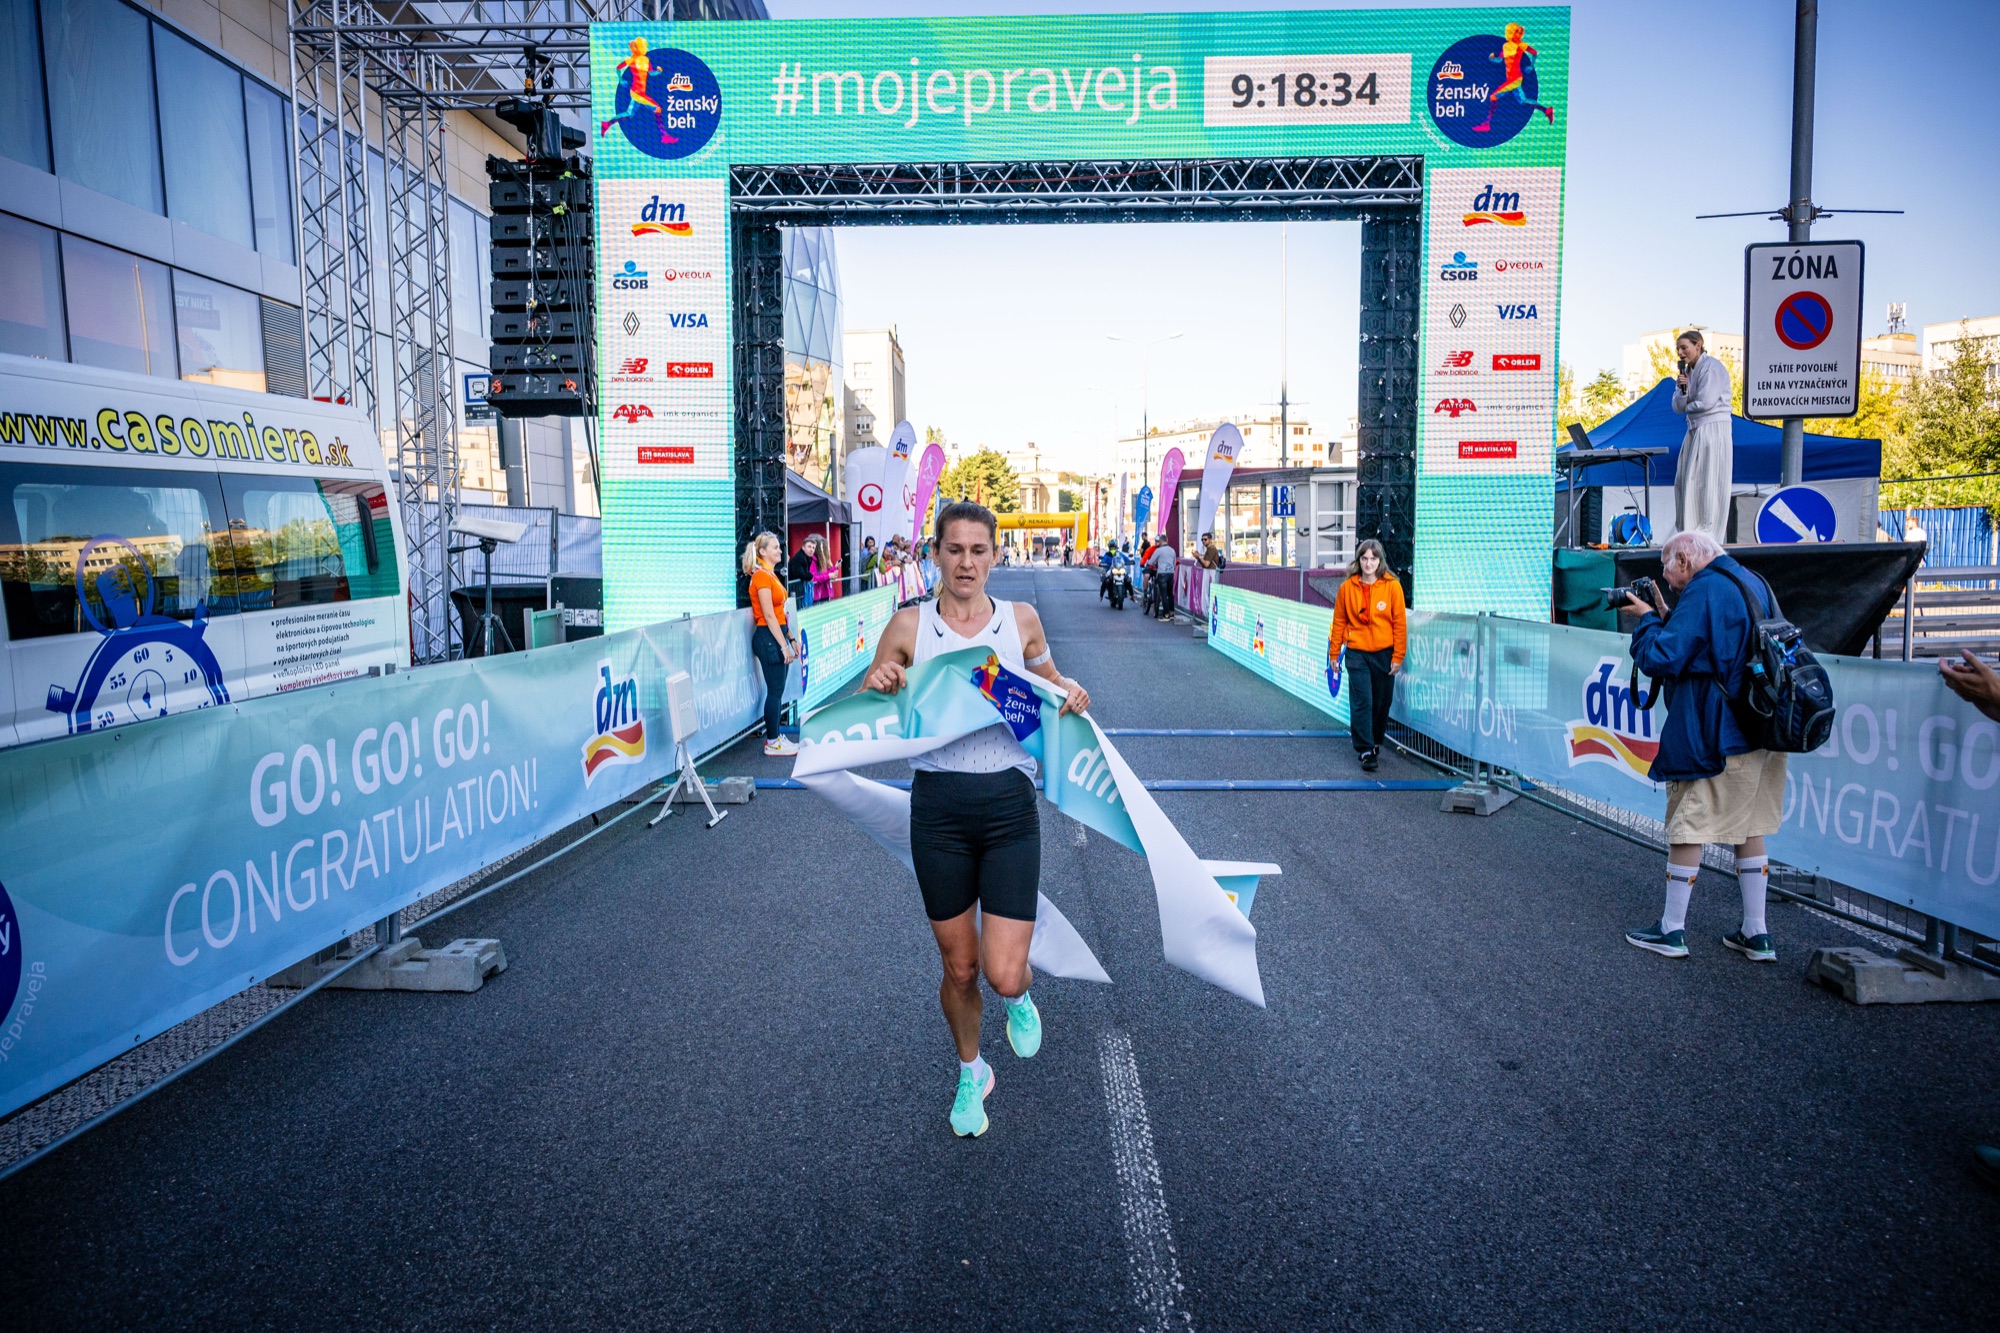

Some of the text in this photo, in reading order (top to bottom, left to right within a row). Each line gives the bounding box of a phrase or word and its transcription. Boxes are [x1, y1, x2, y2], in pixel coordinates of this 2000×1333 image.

[771, 54, 1177, 128] #mojepraveja
[1231, 73, 1380, 109] 9:18:34
[1436, 83, 1490, 102] ženský
[667, 95, 719, 114] ženský
[1436, 102, 1465, 117] beh
[667, 113, 696, 129] beh
[1473, 185, 1520, 212] dm
[641, 196, 685, 222] dm
[1772, 249, 1839, 280] ZÓNA
[678, 271, 711, 279] VEOLIA
[666, 313, 708, 328] VISA
[1495, 304, 1538, 320] VISA
[1769, 361, 1838, 374] STÁTIE POVOLENÉ
[1757, 377, 1848, 390] LEN NA VYZNAČENÝCH
[1752, 395, 1850, 406] PARKOVACÍCH MIESTACH
[681, 411, 718, 419] organics
[0, 407, 354, 468] www.casomiera.sk
[896, 438, 908, 453] dm
[1217, 440, 1232, 455] dm
[275, 609, 351, 628] profesionálne meranie času
[276, 626, 316, 640] elektronickou
[321, 622, 342, 634] čipovou
[343, 618, 375, 629] technológiou
[276, 633, 350, 653] na športových podujatiach
[134, 647, 149, 664] 60
[165, 649, 173, 663] 5
[278, 655, 298, 666] výroba
[299, 648, 329, 662] štartových
[1433, 637, 1455, 677] GO!
[1458, 640, 1484, 683] GO!
[313, 661, 325, 671] LED
[325, 659, 341, 669] panel
[109, 672, 127, 690] 55
[184, 668, 198, 685] 10
[280, 677, 312, 692] komplexný
[343, 668, 359, 677] servis
[97, 711, 115, 728] 50
[1005, 709, 1025, 723] beh
[250, 699, 491, 828] GO! GO! GO!
[164, 758, 539, 967] CONGRATULATION!
